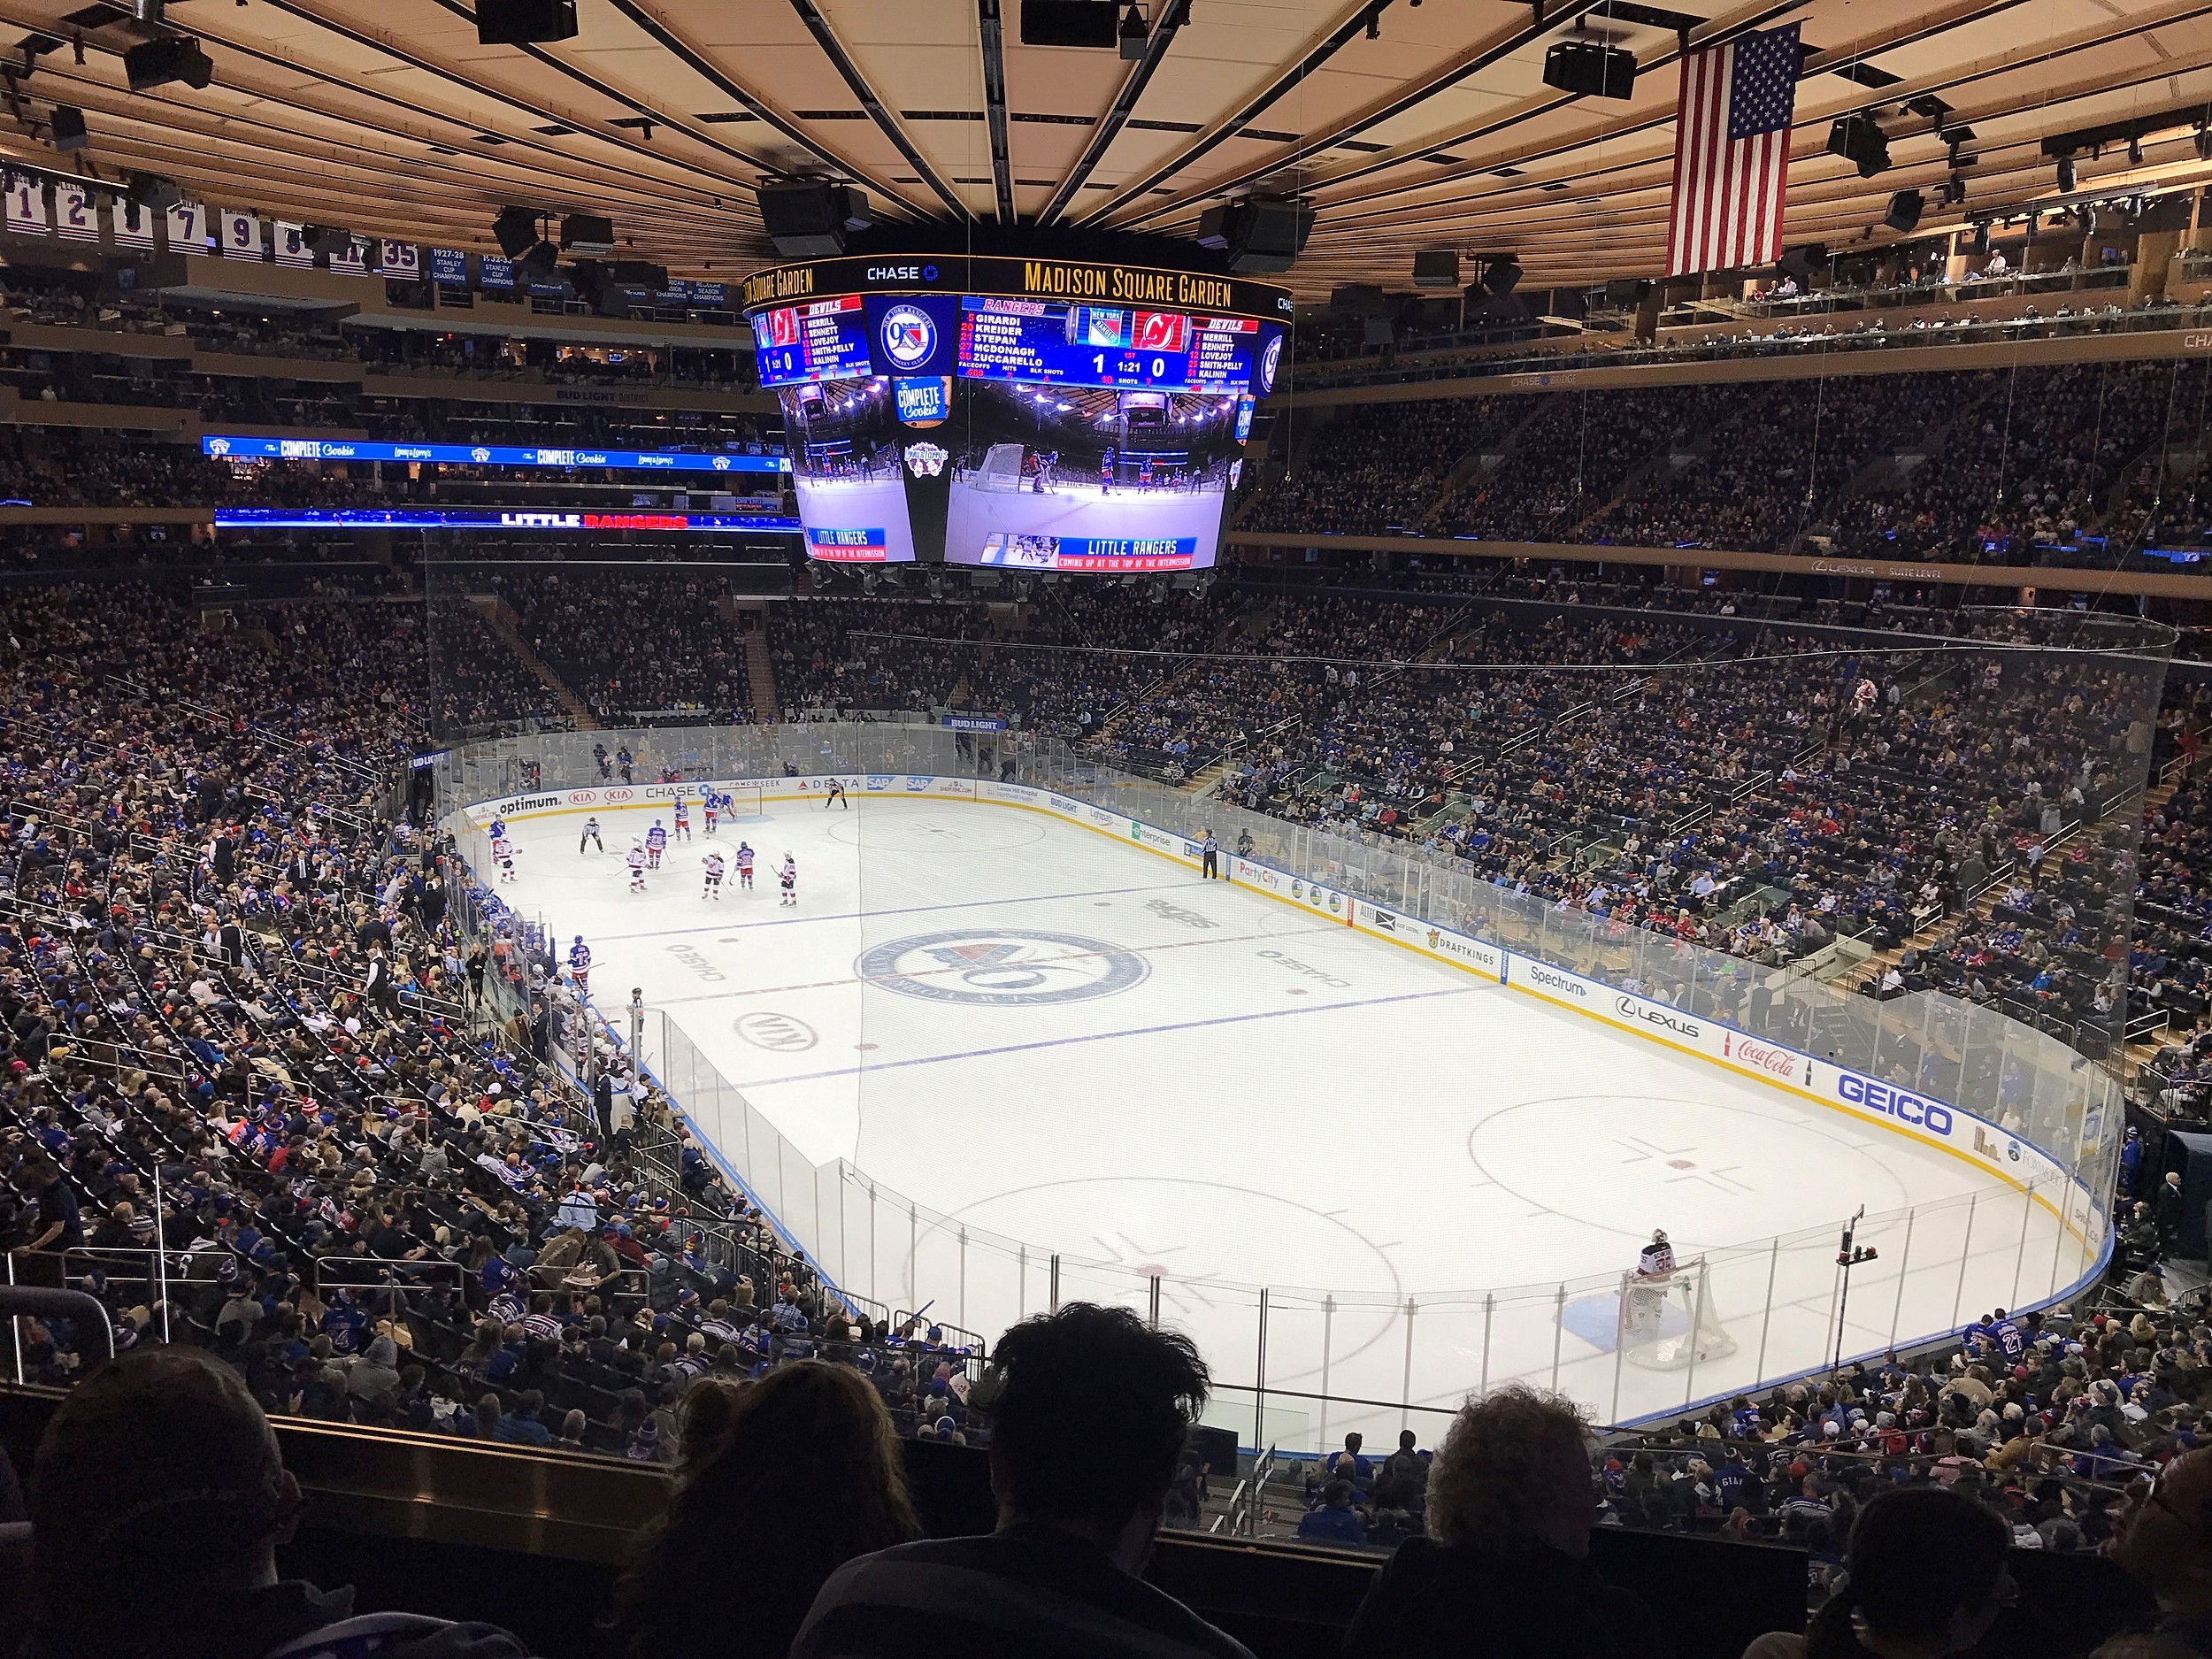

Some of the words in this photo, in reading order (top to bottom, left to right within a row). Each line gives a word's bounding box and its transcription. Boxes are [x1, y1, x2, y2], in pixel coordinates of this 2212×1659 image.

[19, 187, 33, 219] 1
[67, 194, 86, 227] 2
[178, 210, 195, 240] 7
[233, 218, 250, 248] 9
[383, 239, 416, 267] 35
[433, 248, 465, 259] 1927-28
[433, 273, 466, 281] CHAMPIONS
[867, 266, 919, 281] CHASE
[481, 277, 514, 286] CHAMPIONS
[776, 267, 814, 297] GARDEN
[1025, 262, 1107, 296] MADISON
[1112, 267, 1174, 303] SQUARE
[1179, 274, 1232, 308] GARDEN
[656, 291, 687, 300] CHAMPIONS
[693, 294, 725, 303] CHAMPIONS
[808, 300, 842, 316] DEVILS
[982, 298, 1046, 316] RANGERS
[807, 317, 835, 329] MERRILL
[907, 307, 933, 330] RANGERS
[968, 312, 975, 322] 5
[975, 314, 1021, 327] GIRARDI
[1091, 311, 1105, 319] NEW
[1105, 311, 1121, 320] YORK
[809, 326, 839, 338] BENNETT
[961, 322, 974, 332] 20
[975, 324, 1023, 337] KREIDER
[1094, 319, 1119, 344] RANGERS
[1208, 318, 1245, 332] DEVILS
[810, 335, 840, 347] LOVEJOY
[974, 333, 1017, 346] STEPAN
[1202, 333, 1233, 343] MERRILL
[2184, 334, 2212, 349] CHA
[811, 342, 855, 356] SMITH-PELLY
[973, 343, 1036, 357] MCDONAGH
[1202, 342, 1235, 353] BENNETT
[784, 351, 793, 371] 0
[812, 354, 840, 365] KALININ
[910, 357, 925, 366] CLUB
[972, 352, 1043, 367] ZUCCARELLO
[1201, 351, 1233, 362] LOVEJOY
[958, 361, 991, 370] FACEOFFS
[1093, 353, 1105, 374] 1
[1117, 360, 1141, 373] 1:21
[1152, 357, 1165, 378] 0
[1199, 360, 1244, 372] SMITH-PELLY
[1198, 369, 1228, 380] KALININ
[1511, 375, 1541, 388] CHASE
[1549, 373, 1578, 386] BRIDGE
[556, 389, 581, 400] BUD
[582, 391, 617, 402] LIGHT
[897, 386, 941, 408] COMPLETE
[903, 403, 939, 419] Cookie
[280, 440, 321, 458] COMPLETE
[322, 443, 355, 457] Cookie
[536, 449, 576, 466] COMPLETE
[575, 452, 608, 465] Cookie
[779, 457, 793, 472] CO
[501, 512, 580, 527] LITTLE
[583, 513, 689, 530] RANGERS
[836, 530, 868, 546] RANGERS
[1087, 540, 1127, 556] LITTLE
[1132, 540, 1178, 556] RANGERS
[1058, 557, 1084, 568] COMING
[1085, 558, 1094, 568] UP
[1096, 559, 1106, 569] AT
[1108, 559, 1119, 569] THE
[1122, 559, 1133, 569] TOP
[1135, 558, 1143, 568] OF
[1145, 558, 1156, 569] THE
[1156, 557, 1191, 567] INTERMISSION
[1828, 563, 1876, 575] LEXUS
[1889, 566, 1915, 578] SUITE
[1916, 568, 1941, 580] LEVEL
[950, 718, 972, 729] BUD
[972, 719, 998, 731] LIGHT
[424, 752, 445, 766] LIGHT
[760, 779, 781, 787] SEEK
[867, 777, 890, 789] SAP
[906, 779, 929, 791] SAP
[572, 791, 593, 803] KIA
[609, 789, 629, 801] KIA
[646, 786, 696, 798] CHASE
[1020, 788, 1038, 797] Hospital
[499, 795, 563, 815] optimum.
[1050, 797, 1063, 809] BUD
[1062, 800, 1078, 814] LIGHT
[1090, 807, 1114, 823] Lightpath
[1133, 825, 1171, 847] enterprise
[1440, 938, 1495, 966] DRAFTKINGS
[673, 950, 728, 982] CHASE
[1279, 957, 1353, 989] CHASE
[1530, 965, 1585, 997] Spectrum
[1637, 1006, 1700, 1039] LEXUS
[745, 1017, 809, 1048] KIA
[1838, 1073, 1954, 1136] GEICO
[2001, 1331, 2023, 1355] 27
